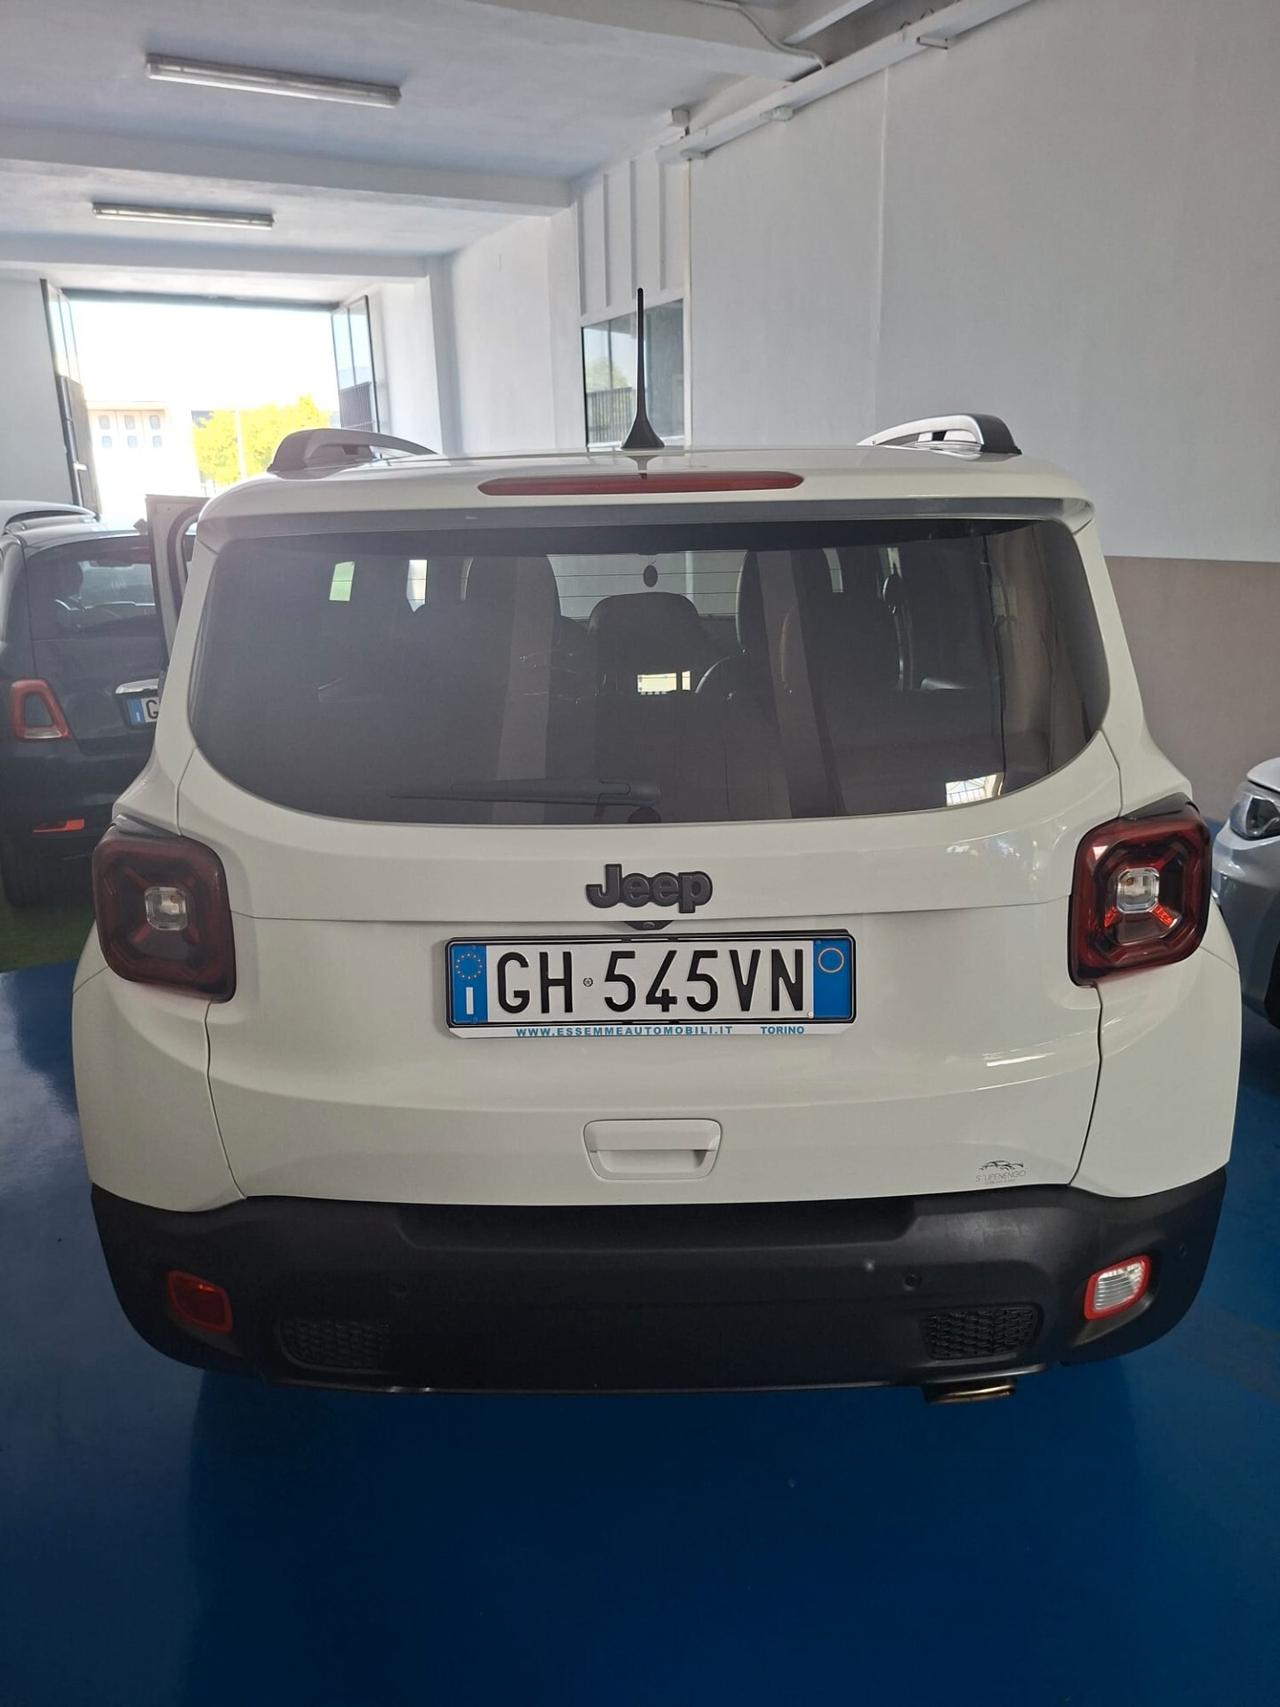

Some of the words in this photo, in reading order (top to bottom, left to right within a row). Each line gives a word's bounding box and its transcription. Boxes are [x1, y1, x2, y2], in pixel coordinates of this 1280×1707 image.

[585, 864, 713, 913] Jeep
[497, 951, 574, 1014] GH
[604, 949, 803, 1012] 545VN
[516, 1026, 733, 1037] WWW.ESSEMMEAUTOMOBILI.IT
[760, 1026, 805, 1035] TORINO
